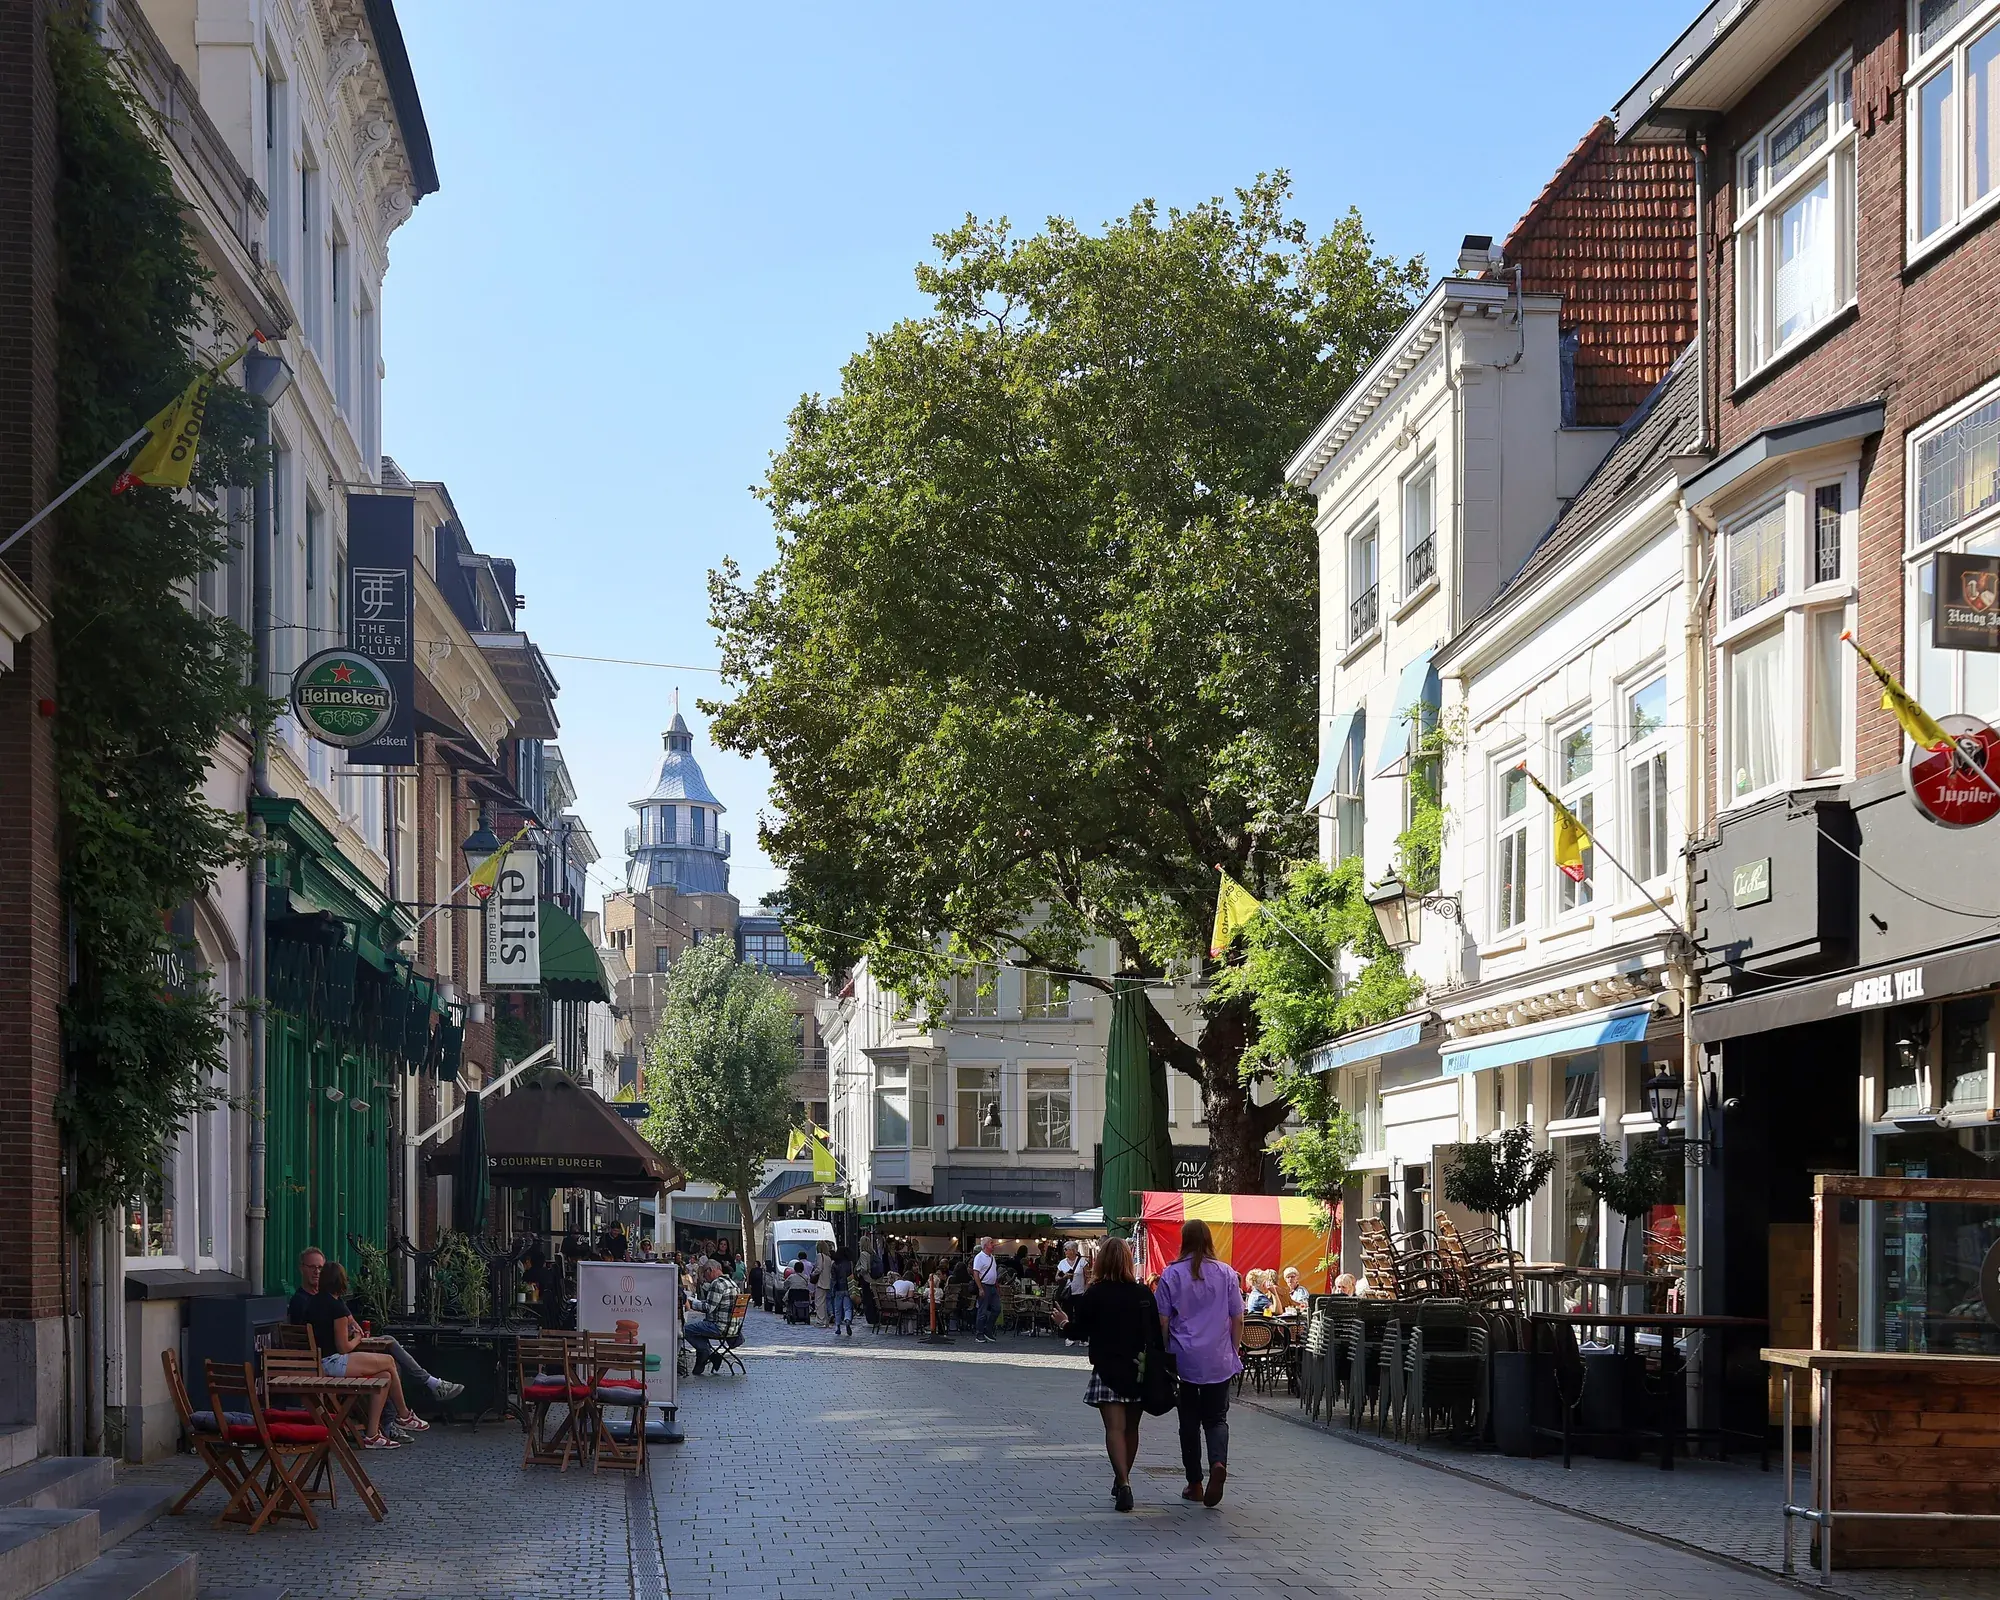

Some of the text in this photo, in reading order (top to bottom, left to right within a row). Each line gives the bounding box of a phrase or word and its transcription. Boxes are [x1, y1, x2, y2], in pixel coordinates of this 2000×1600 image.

[1947, 608, 1987, 627] Hertog
[359, 624, 386, 634] THE
[359, 634, 402, 645] TIGER
[359, 645, 396, 656] CLUB
[301, 687, 386, 706] Heineken
[1932, 786, 1997, 806] Jupiler
[500, 869, 536, 966] ellis
[488, 922, 497, 965] BURGER
[1851, 974, 1893, 1009] REBEL
[1894, 967, 1925, 1001] YELL
[501, 1156, 554, 1166] GOURMET
[557, 1157, 603, 1168] BURGER
[601, 1294, 653, 1307] GIVISA
